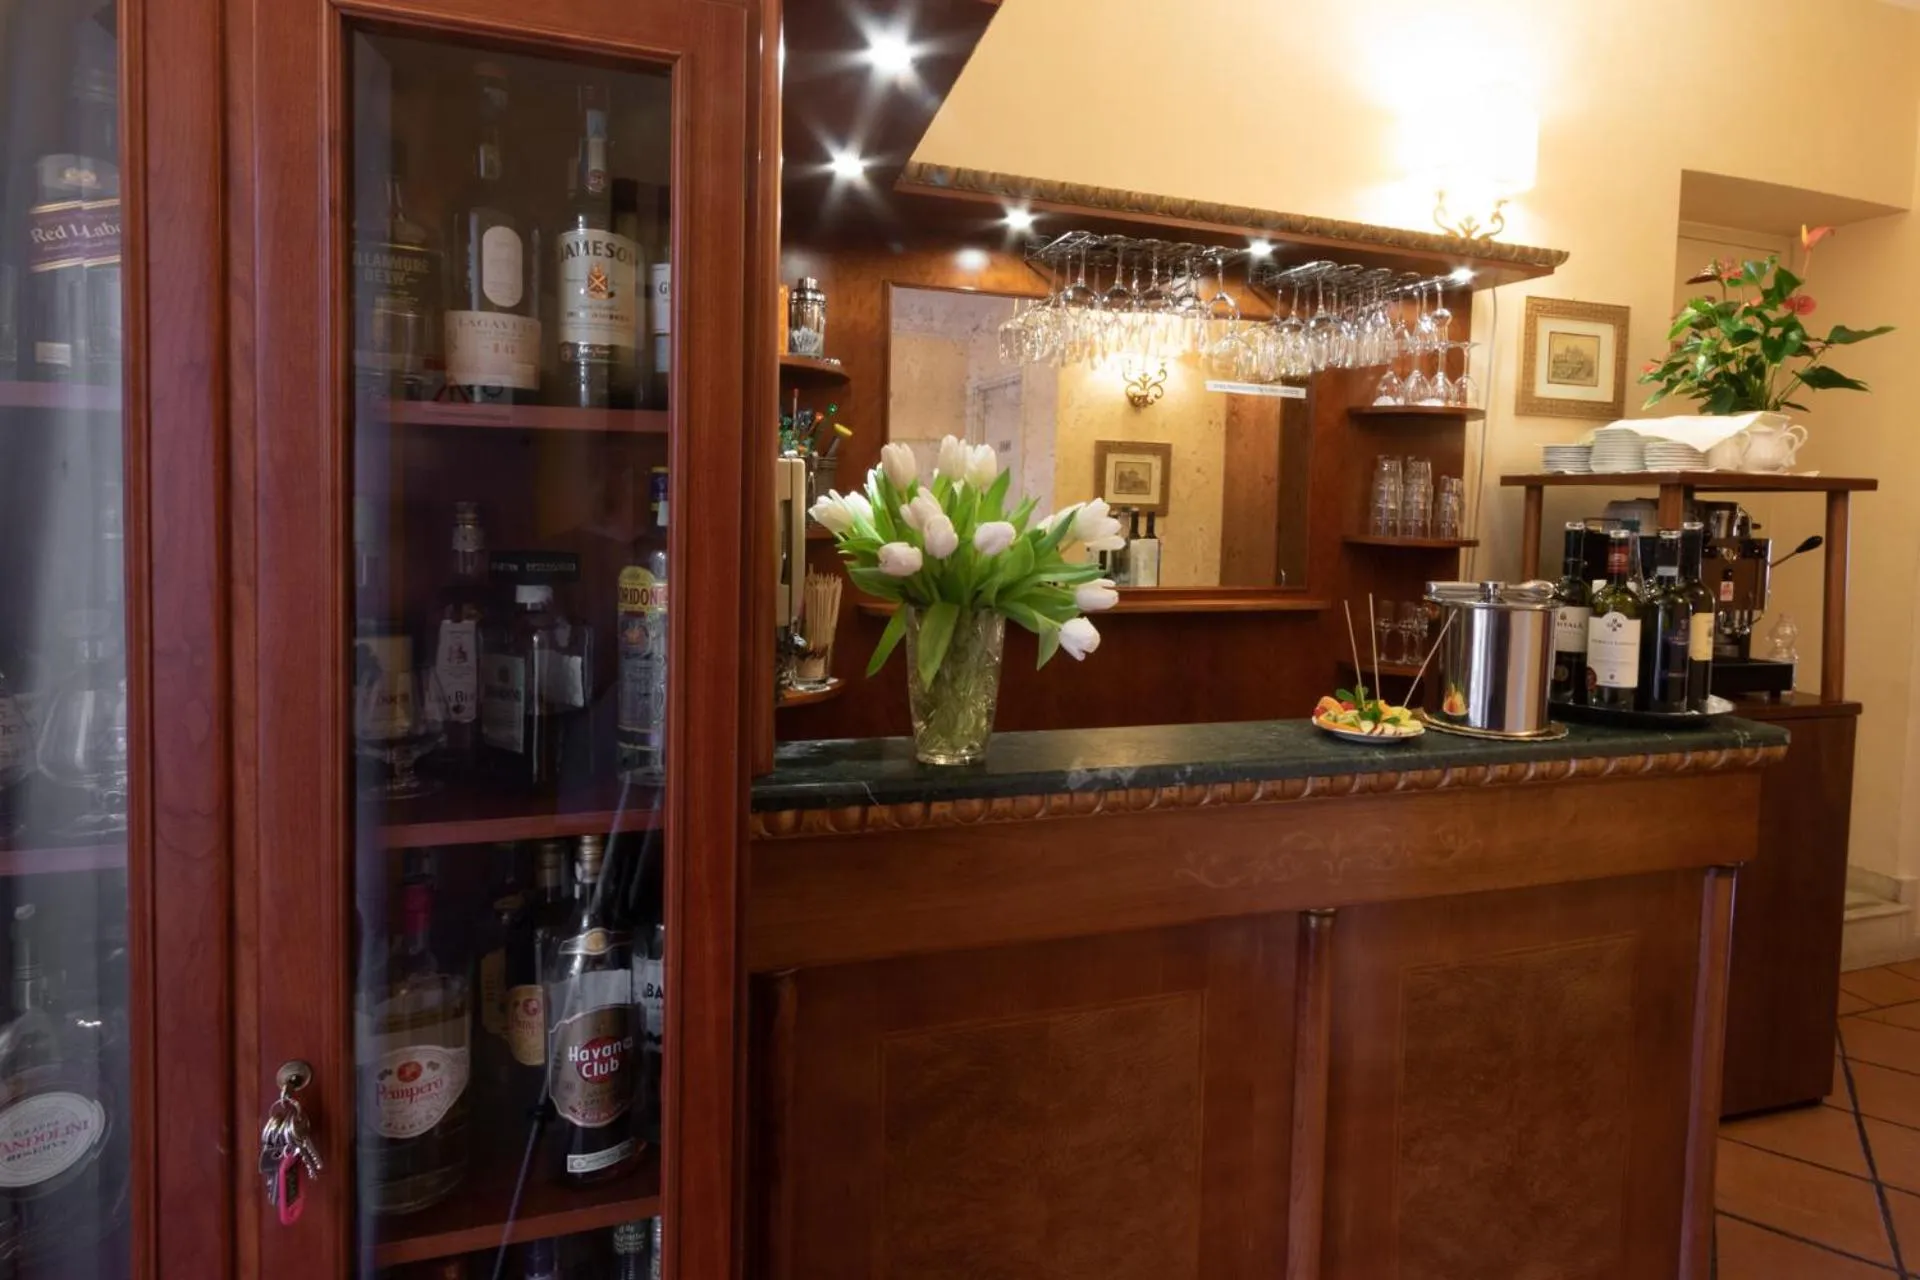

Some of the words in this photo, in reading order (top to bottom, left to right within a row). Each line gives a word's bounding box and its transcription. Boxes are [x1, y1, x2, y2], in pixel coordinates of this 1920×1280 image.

[30, 223, 67, 243] Red
[567, 1035, 634, 1062] Havana
[581, 1056, 620, 1079] Club
[374, 1075, 444, 1107] Pampero
